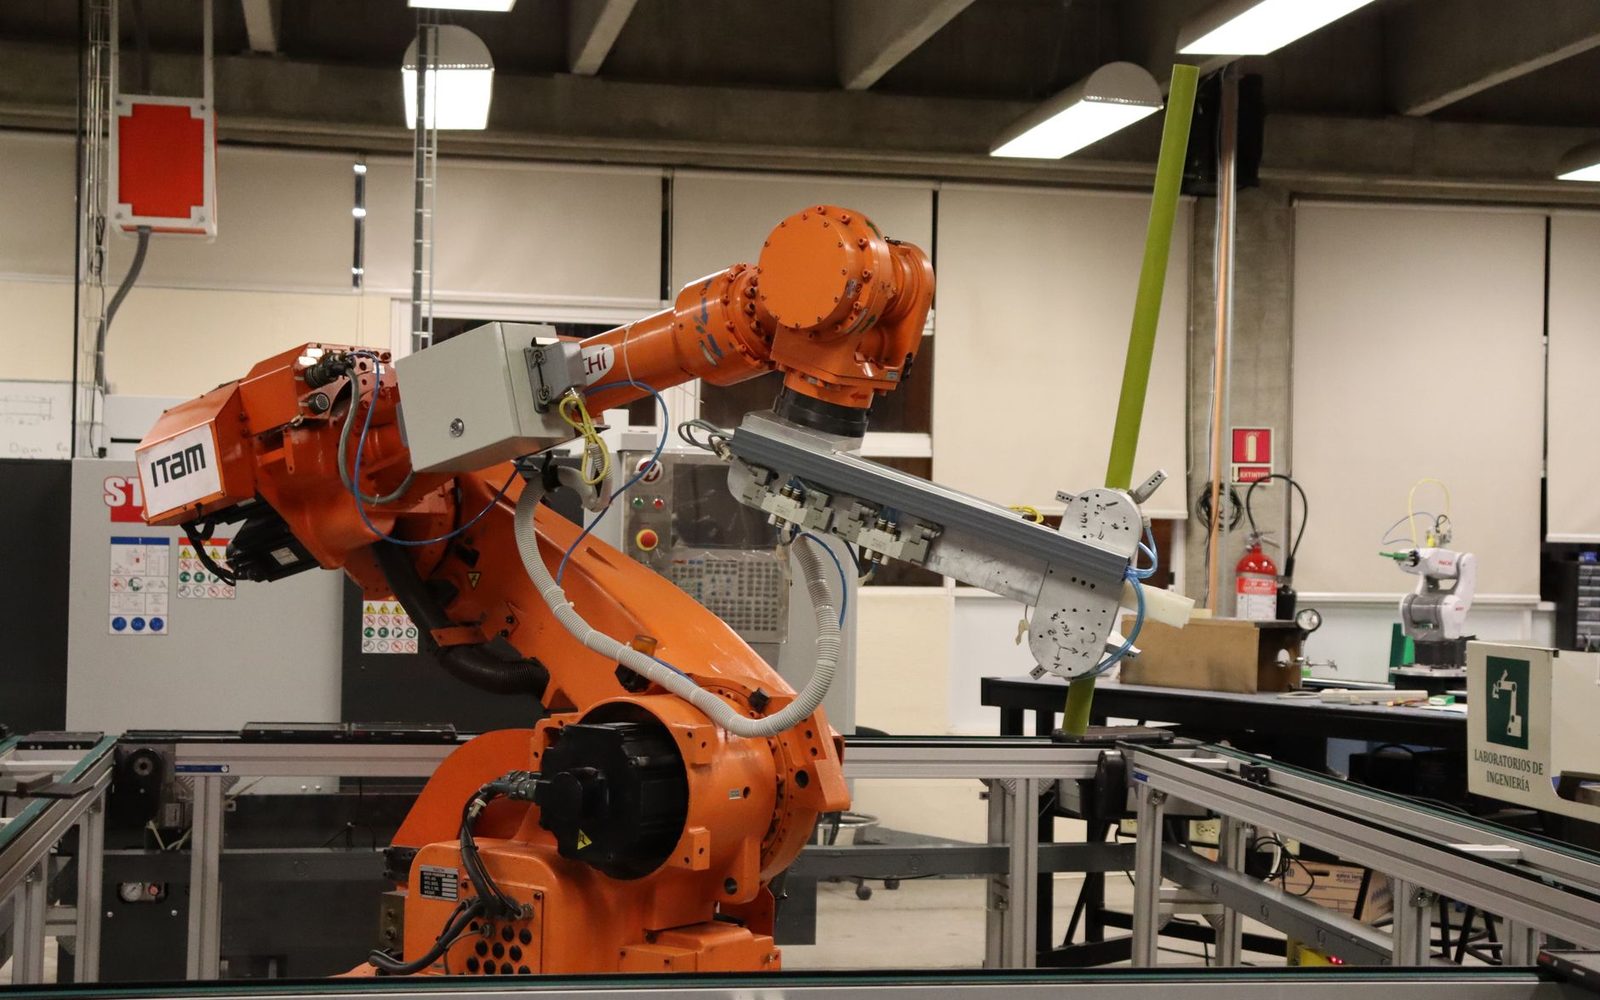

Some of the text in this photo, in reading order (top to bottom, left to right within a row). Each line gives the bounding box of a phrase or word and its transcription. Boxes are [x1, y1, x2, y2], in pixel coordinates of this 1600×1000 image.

[1474, 749, 1544, 775] LABORATORIOS DE
[1486, 770, 1530, 792] INGENIERÍA
